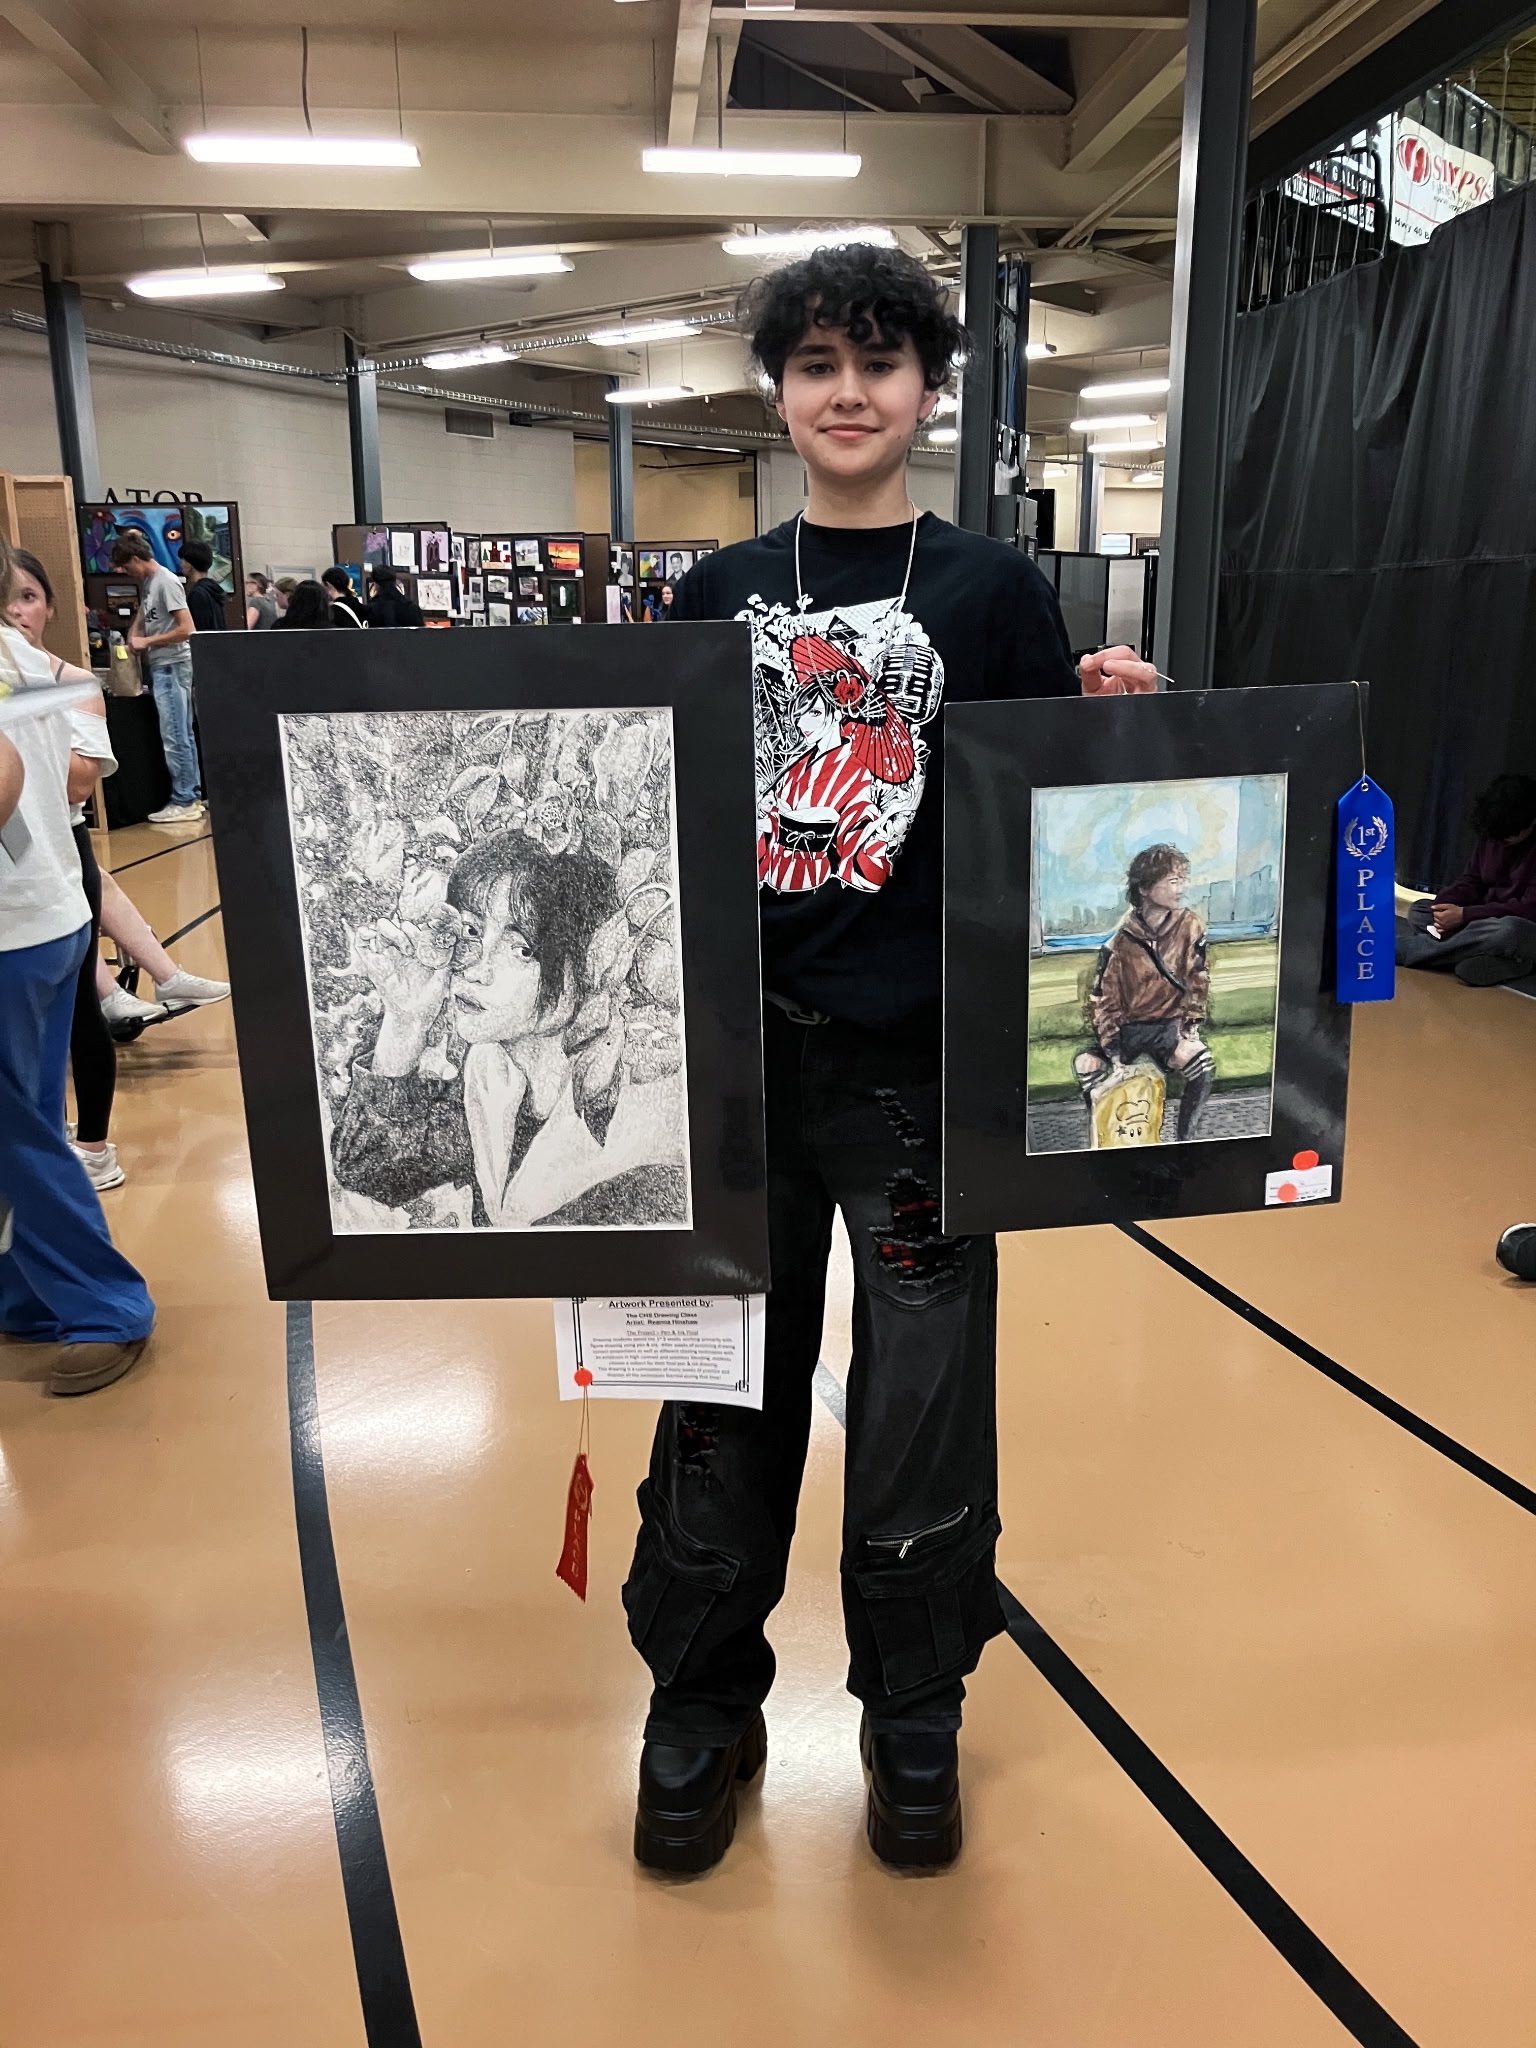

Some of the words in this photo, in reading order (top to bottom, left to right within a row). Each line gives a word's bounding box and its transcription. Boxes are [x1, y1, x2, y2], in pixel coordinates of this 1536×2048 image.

[1357, 825, 1376, 846] 1st
[1356, 869, 1376, 980] PLACE
[608, 1299, 648, 1309] Artwork
[649, 1299, 698, 1308] Presented
